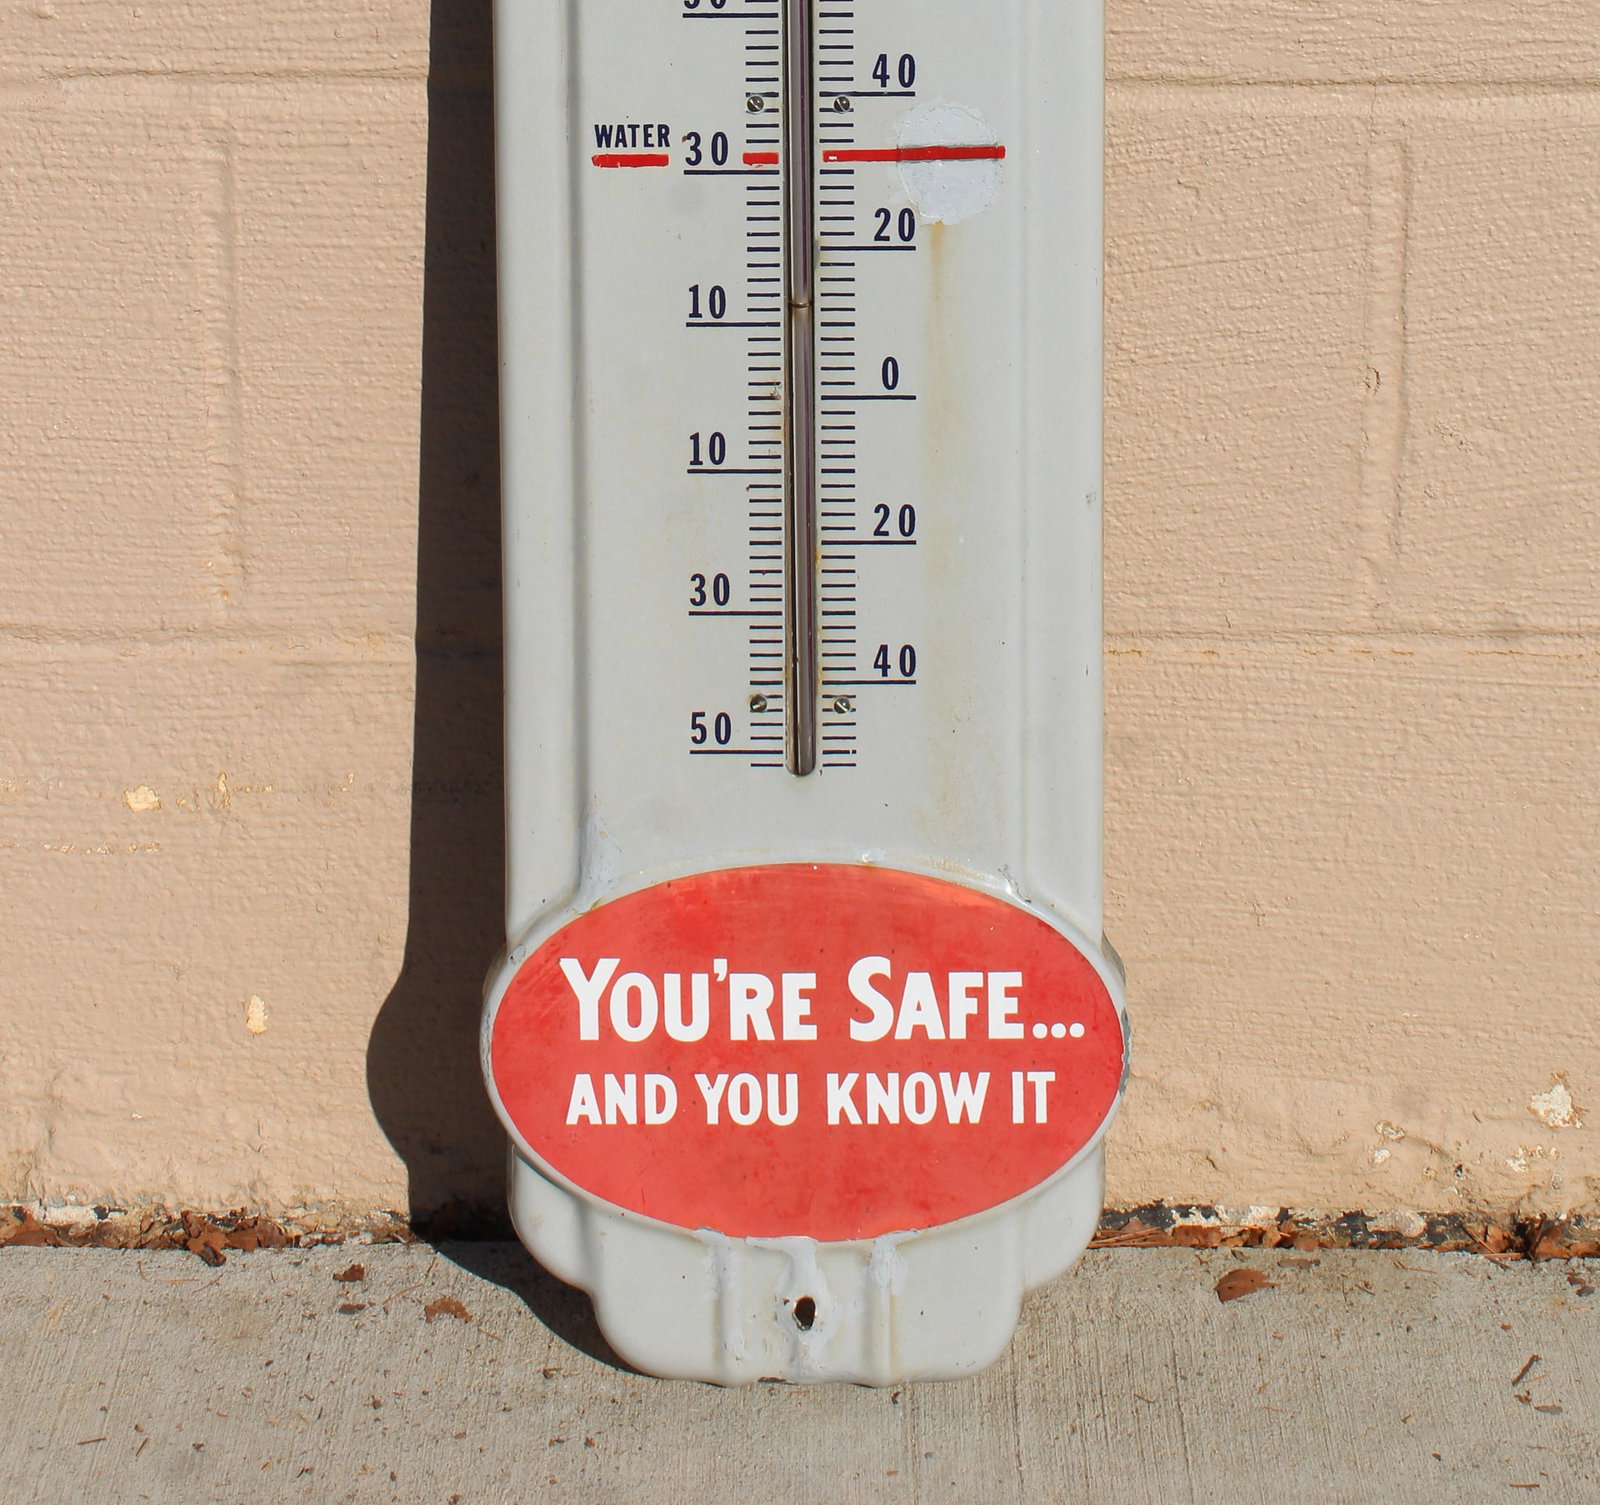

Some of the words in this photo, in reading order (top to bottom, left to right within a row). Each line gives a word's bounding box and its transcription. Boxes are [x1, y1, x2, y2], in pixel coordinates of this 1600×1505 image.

[872, 53, 916, 89] 40
[594, 123, 671, 149] WATER
[684, 131, 729, 167] 30
[873, 207, 916, 243] 20
[688, 284, 727, 320] 10
[881, 356, 899, 391] 0
[689, 431, 726, 466] 10
[873, 503, 916, 538] 20
[689, 572, 731, 607] 30
[873, 644, 917, 678] 40
[690, 711, 732, 746] 50
[558, 957, 818, 1043] YOU'RE
[565, 1073, 678, 1125] AND
[694, 1072, 799, 1126] YOU
[826, 1071, 991, 1125] KNOW
[1011, 1071, 1056, 1124] IT
